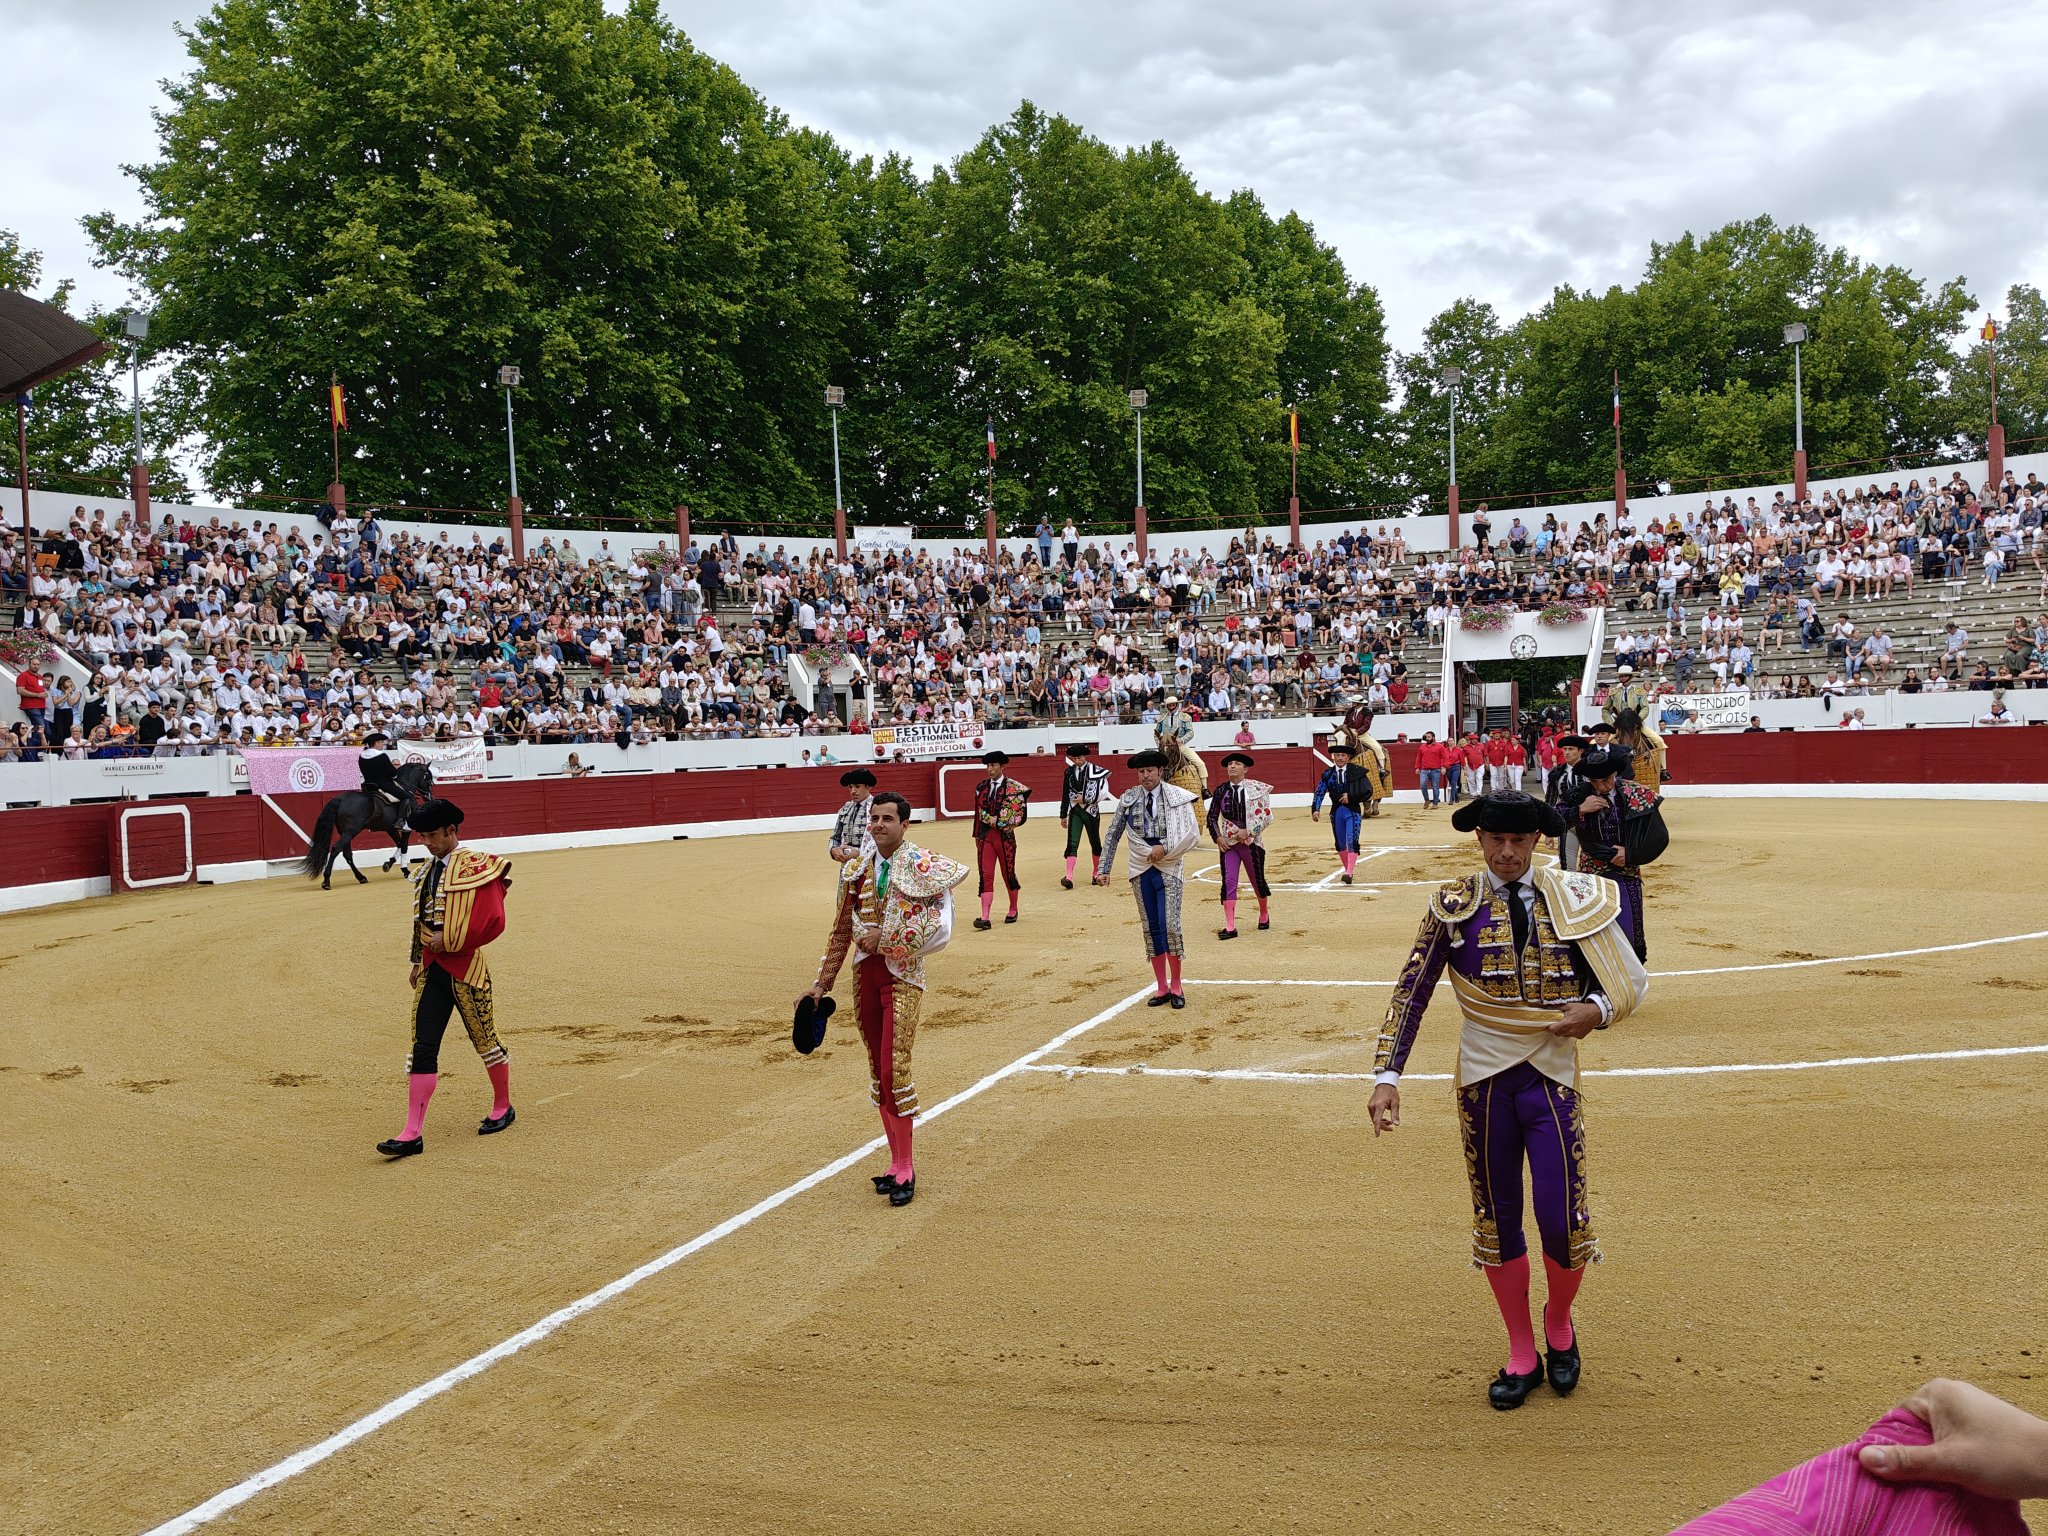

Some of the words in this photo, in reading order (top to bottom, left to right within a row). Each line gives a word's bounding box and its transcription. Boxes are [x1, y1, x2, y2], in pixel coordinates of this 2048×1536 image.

[858, 539, 883, 548] Carlos
[1693, 696, 1745, 709] TENDIDO
[896, 724, 957, 737] FESTIVAL
[896, 733, 959, 743] EXCEPTIONNEL
[893, 747, 926, 755] DOUR
[928, 744, 966, 753] AFICION
[234, 764, 248, 776] AC
[300, 769, 315, 785] 69
